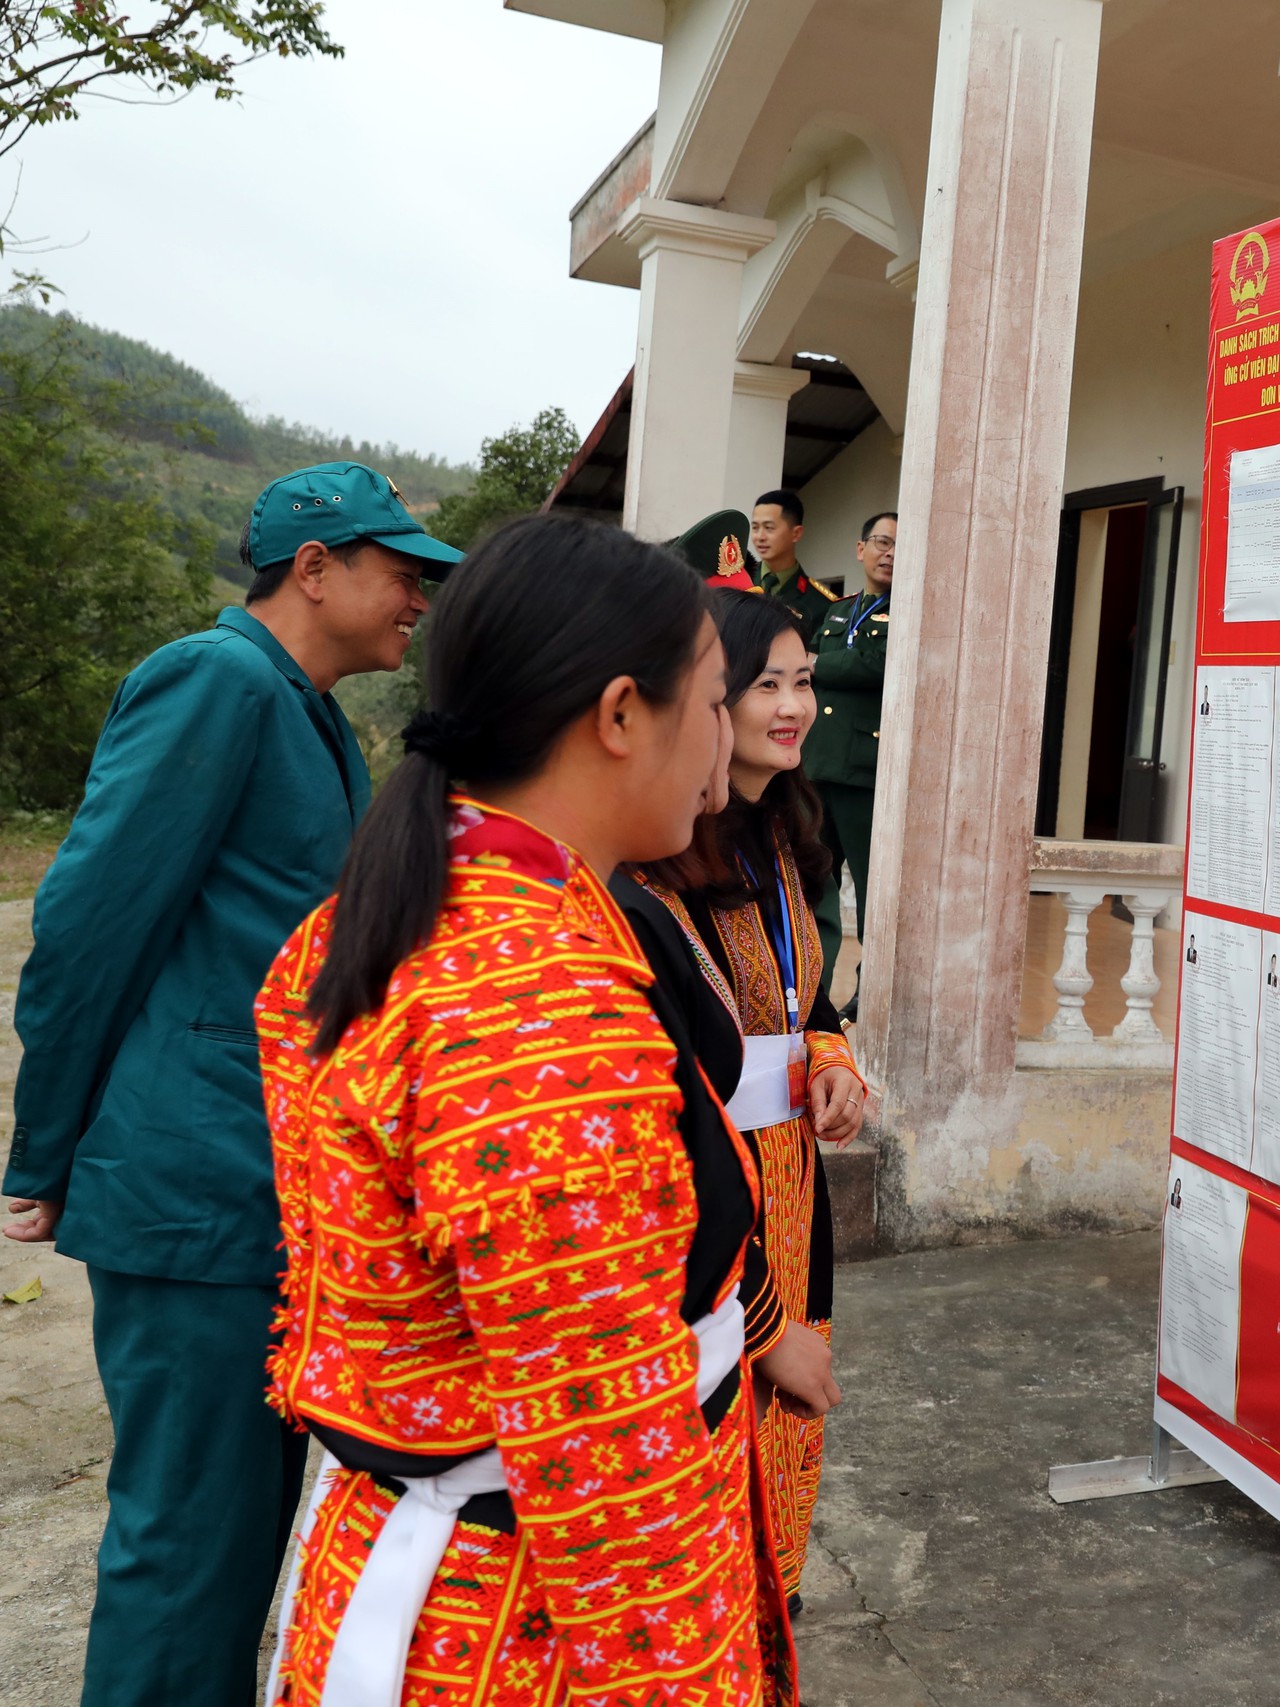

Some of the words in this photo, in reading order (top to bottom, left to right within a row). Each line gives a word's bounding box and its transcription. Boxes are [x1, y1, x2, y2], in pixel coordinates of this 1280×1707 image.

[1219, 336, 1238, 358] DANH
[1239, 330, 1257, 352] SÁCH
[1259, 324, 1279, 346] TRÍCH
[1224, 364, 1238, 385] ỨNG
[1239, 356, 1250, 382] CỬ
[1251, 356, 1266, 378] VIÊN
[1267, 354, 1280, 374] ĐẠI
[1260, 386, 1276, 406] ĐƠN
